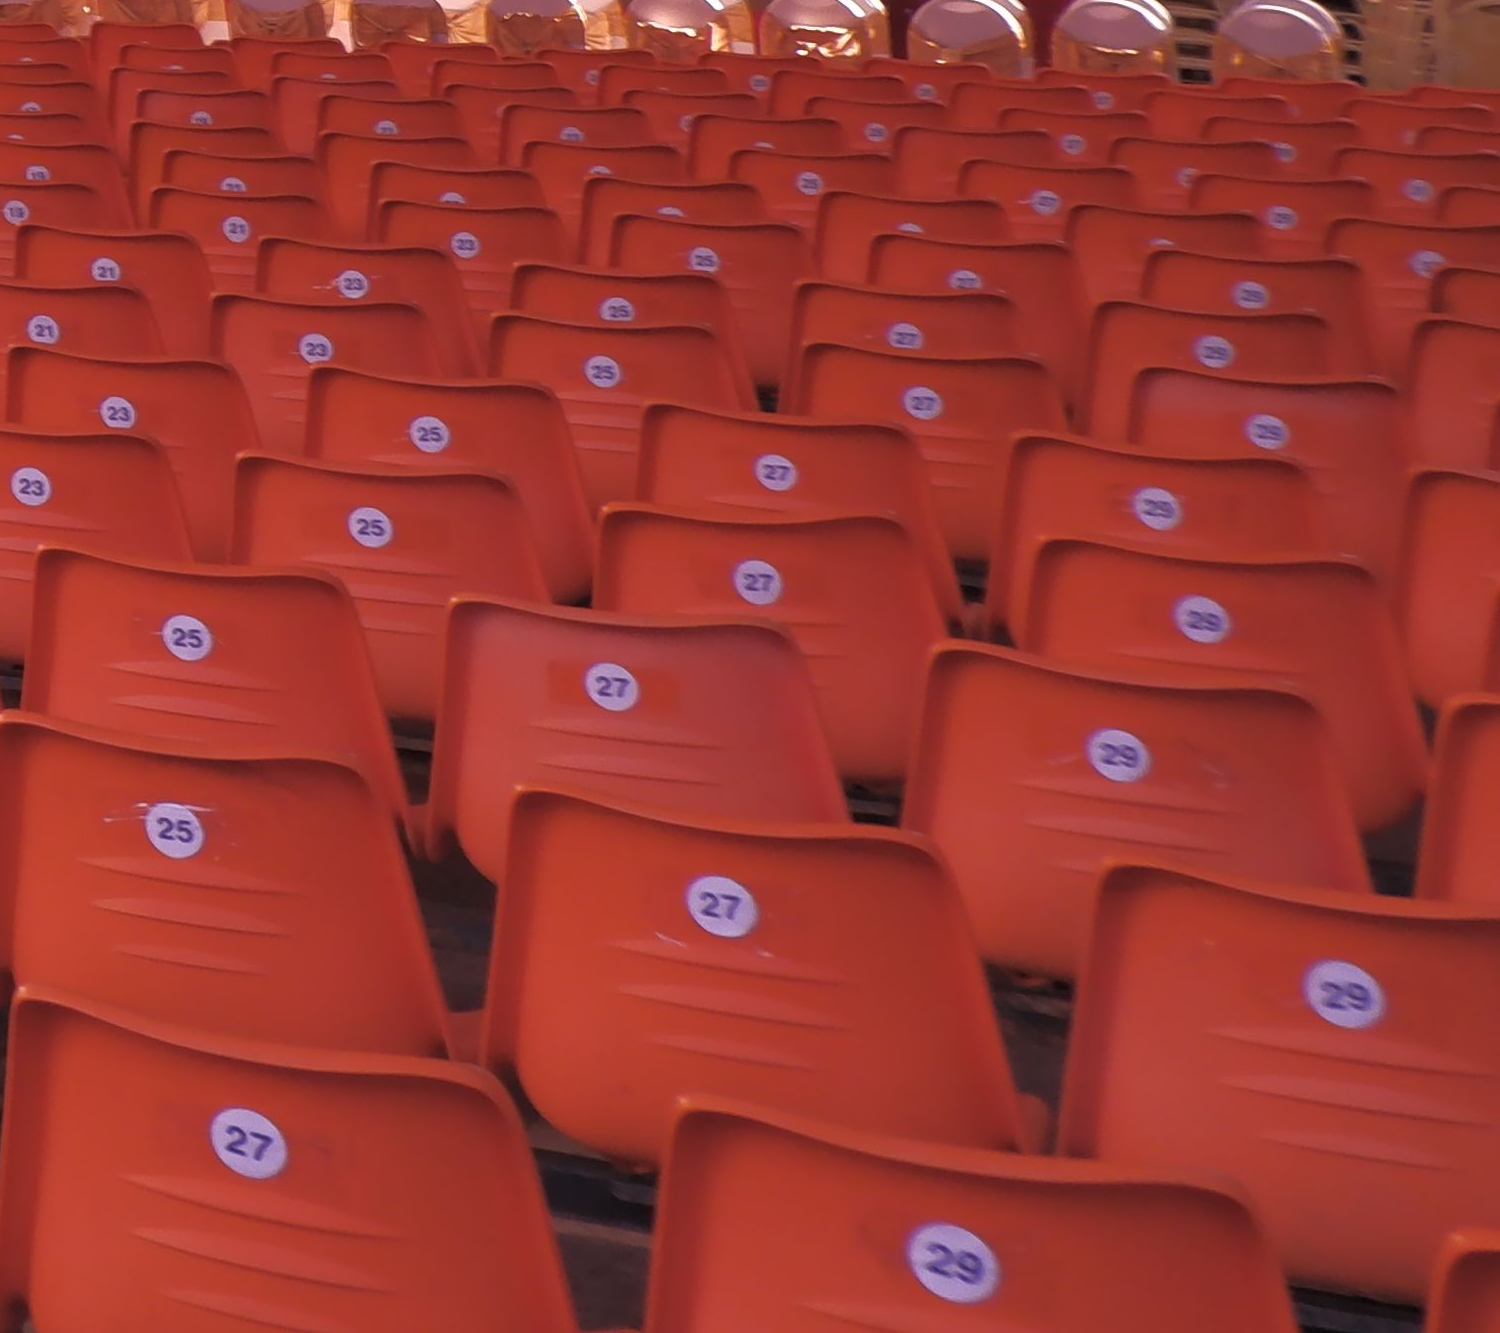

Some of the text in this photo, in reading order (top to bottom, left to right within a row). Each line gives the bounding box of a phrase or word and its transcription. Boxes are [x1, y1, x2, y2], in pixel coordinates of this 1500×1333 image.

[35, 324, 54, 338] 21
[306, 343, 328, 357] 23
[108, 406, 131, 421] 23
[417, 427, 444, 442] 25
[19, 478, 45, 496] 23
[357, 519, 386, 536] 25
[744, 573, 774, 591] 27
[172, 628, 203, 648] 25
[596, 676, 630, 697] 27
[157, 817, 194, 843] 25
[700, 892, 742, 919] 27
[1321, 981, 1372, 1011] 29
[225, 1126, 273, 1161] 27
[926, 1243, 985, 1284] 29
